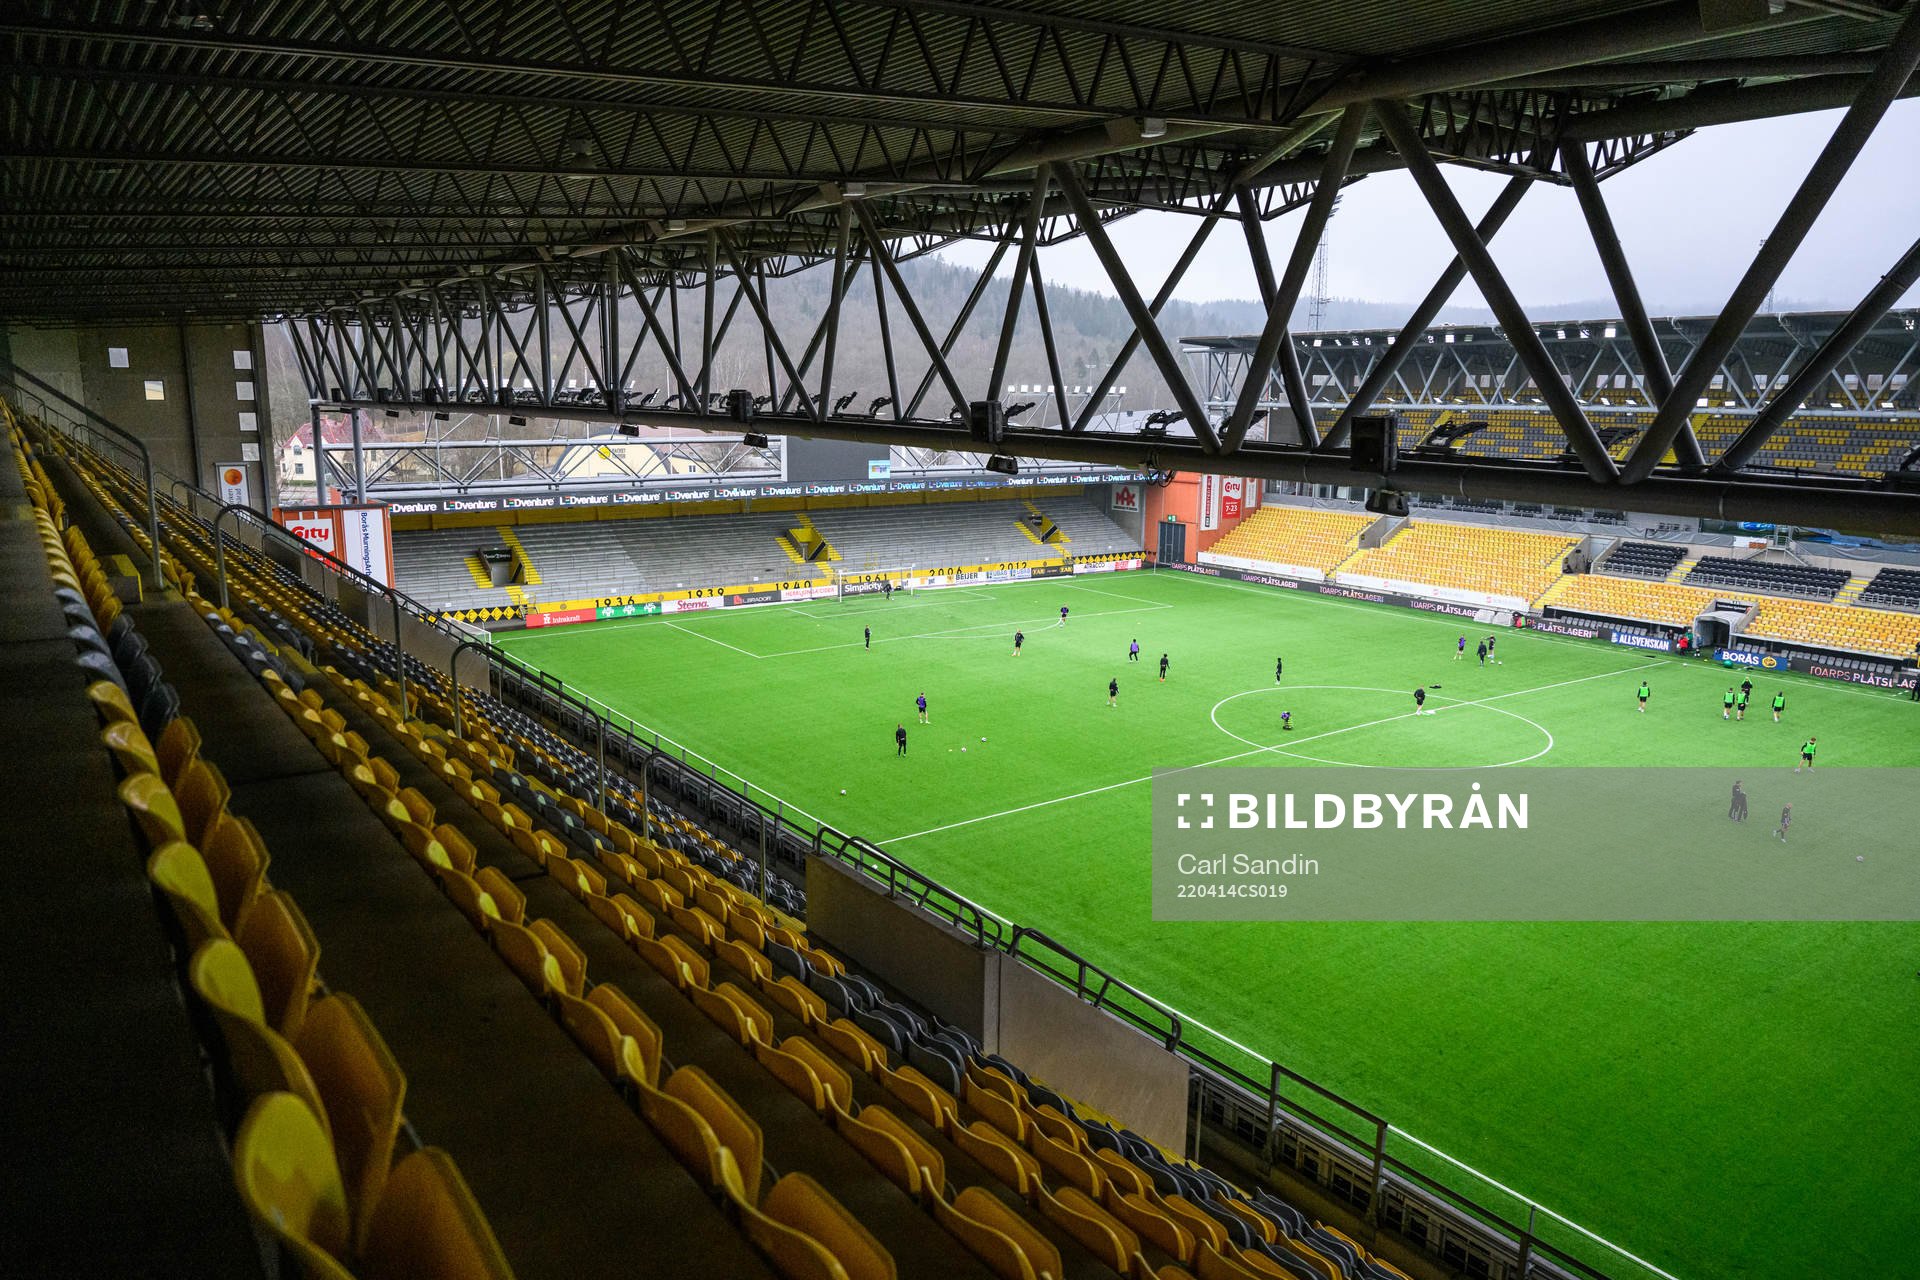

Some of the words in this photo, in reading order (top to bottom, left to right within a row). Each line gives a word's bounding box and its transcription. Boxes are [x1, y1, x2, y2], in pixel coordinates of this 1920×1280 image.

[291, 526, 329, 541] City
[775, 581, 811, 591] 1940
[858, 573, 888, 583] 1961
[595, 595, 635, 607] 1936
[687, 587, 724, 599] 1939
[1319, 586, 1341, 597] TOARPS
[1342, 589, 1384, 602] PLÅTSLAGERI
[1410, 600, 1436, 611] TOARPS
[1437, 603, 1478, 618] PLÅTSLAGE
[1537, 621, 1592, 638] PLÅTSLAGERI
[1619, 633, 1669, 651] ALLSVENSKAN
[1722, 648, 1760, 665] BORÅS
[1809, 665, 1850, 681] TOARPS
[1852, 672, 1917, 689] PLÅTSLAG
